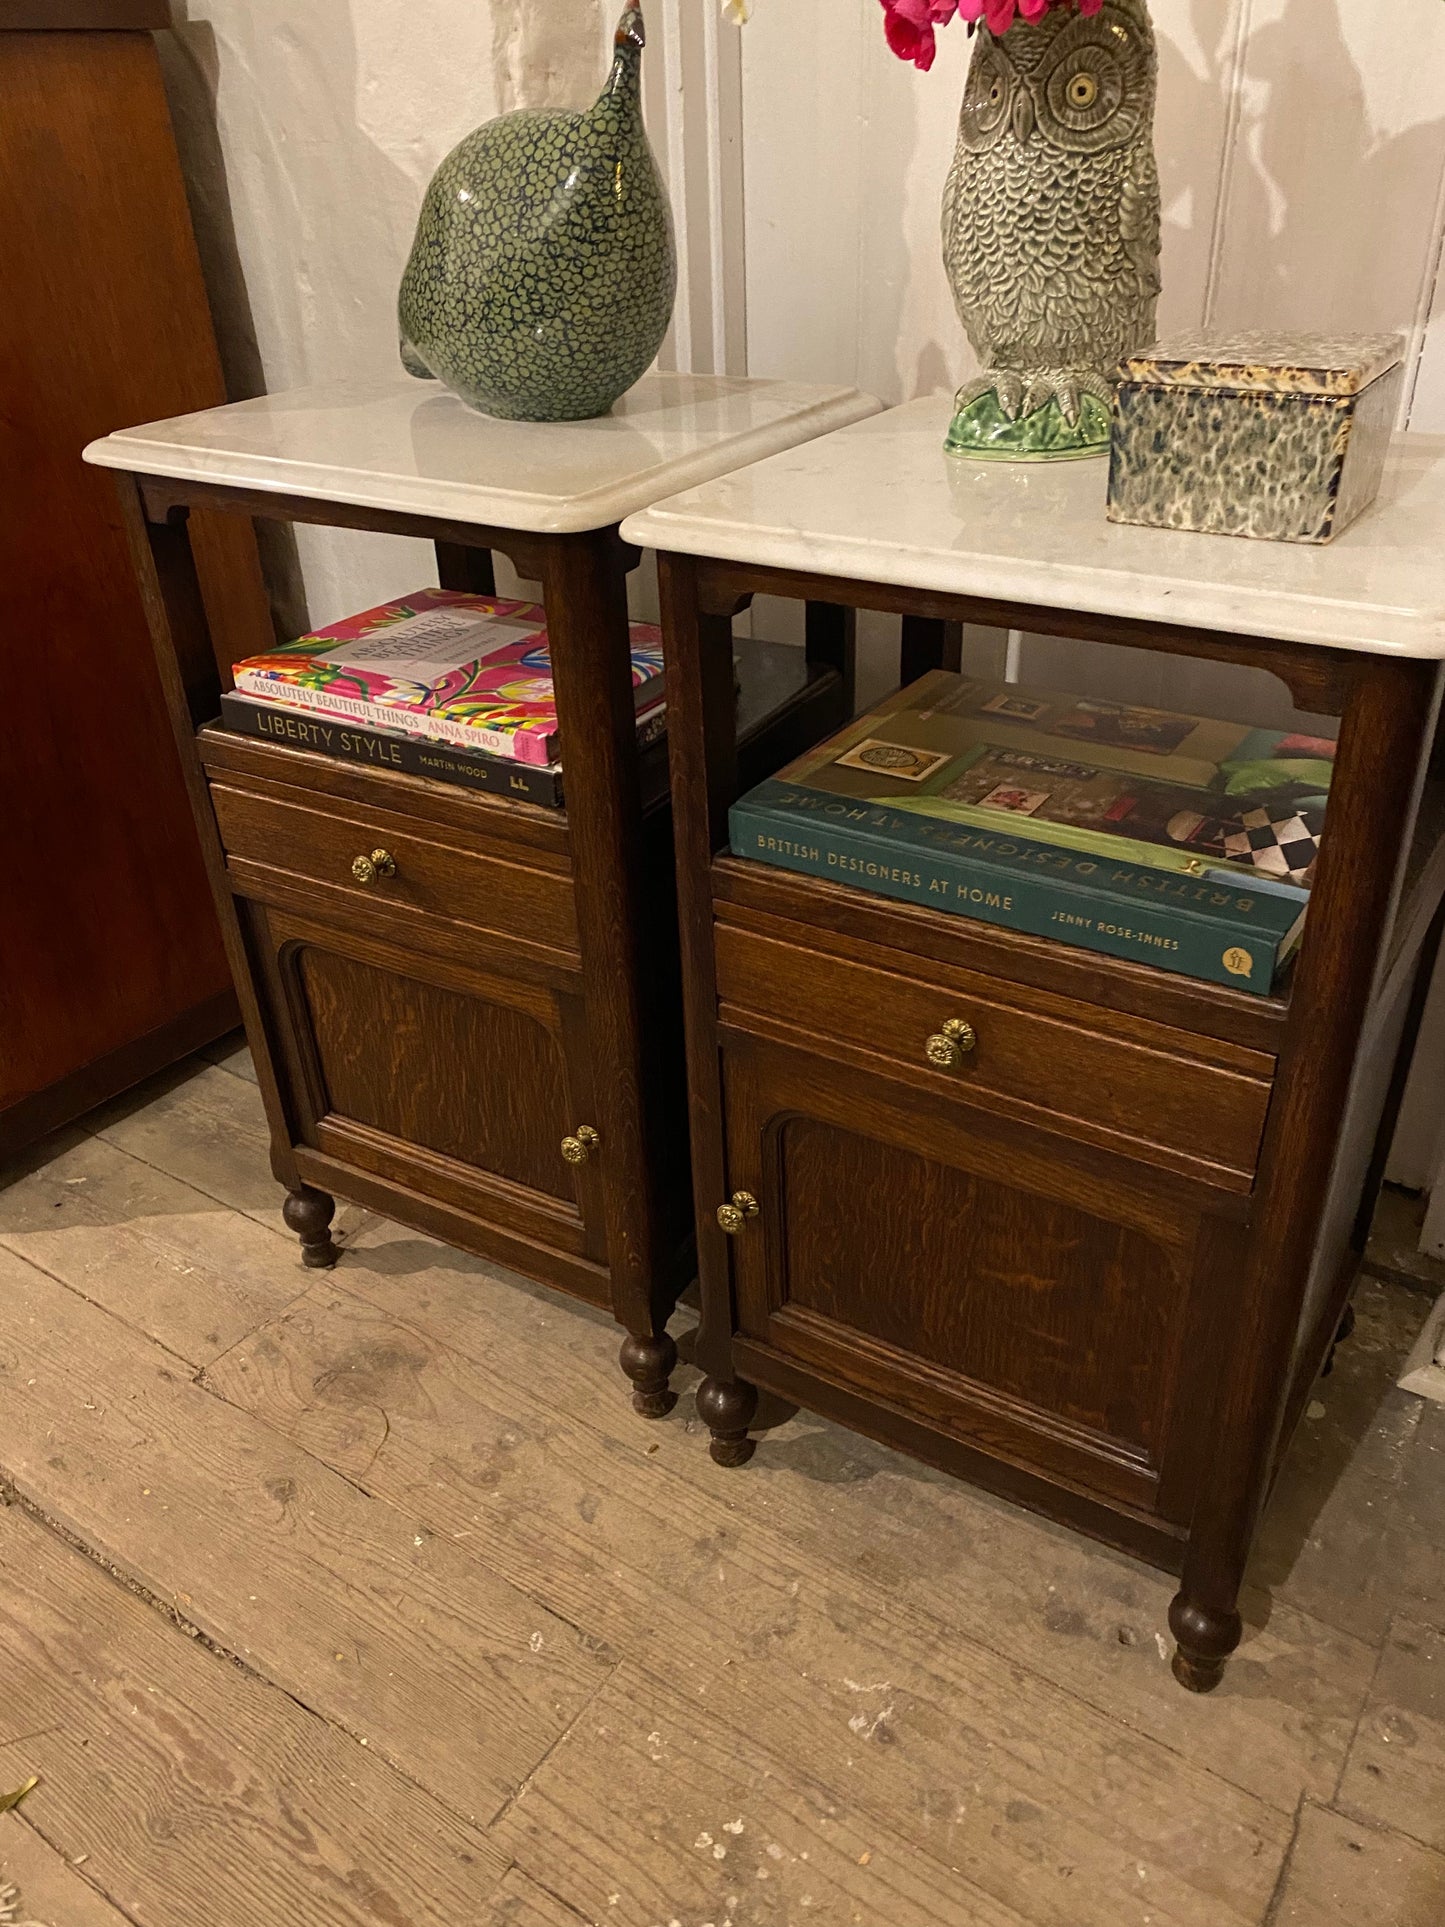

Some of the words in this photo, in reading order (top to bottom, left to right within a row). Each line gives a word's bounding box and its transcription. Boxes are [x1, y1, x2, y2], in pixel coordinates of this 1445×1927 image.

[350, 614, 452, 660] ABSOLUTELY
[371, 619, 467, 660] BEAUTIFUL
[399, 627, 471, 658] THINGS
[253, 680, 314, 703] ABSOLUTELY
[315, 693, 374, 717] BEAUTIFUL
[374, 707, 419, 729] THINGS
[428, 721, 462, 740] ANNA
[464, 728, 500, 749] SPIRO
[256, 712, 333, 747] LIBERTY
[340, 732, 402, 764] STYLE
[418, 755, 455, 772] MARTIN
[457, 765, 488, 780] WOOD
[779, 792, 867, 821] HOME
[872, 814, 904, 830] AT
[918, 826, 1098, 875] DESIGNERS
[757, 834, 820, 862] BRITISH
[826, 851, 922, 888] DESIGNERS
[929, 877, 949, 894] AT
[957, 884, 1013, 911] HOME
[1111, 869, 1256, 913] BRITISH
[1051, 910, 1092, 929] JENNY
[1097, 921, 1180, 951] ROSE-INNES
